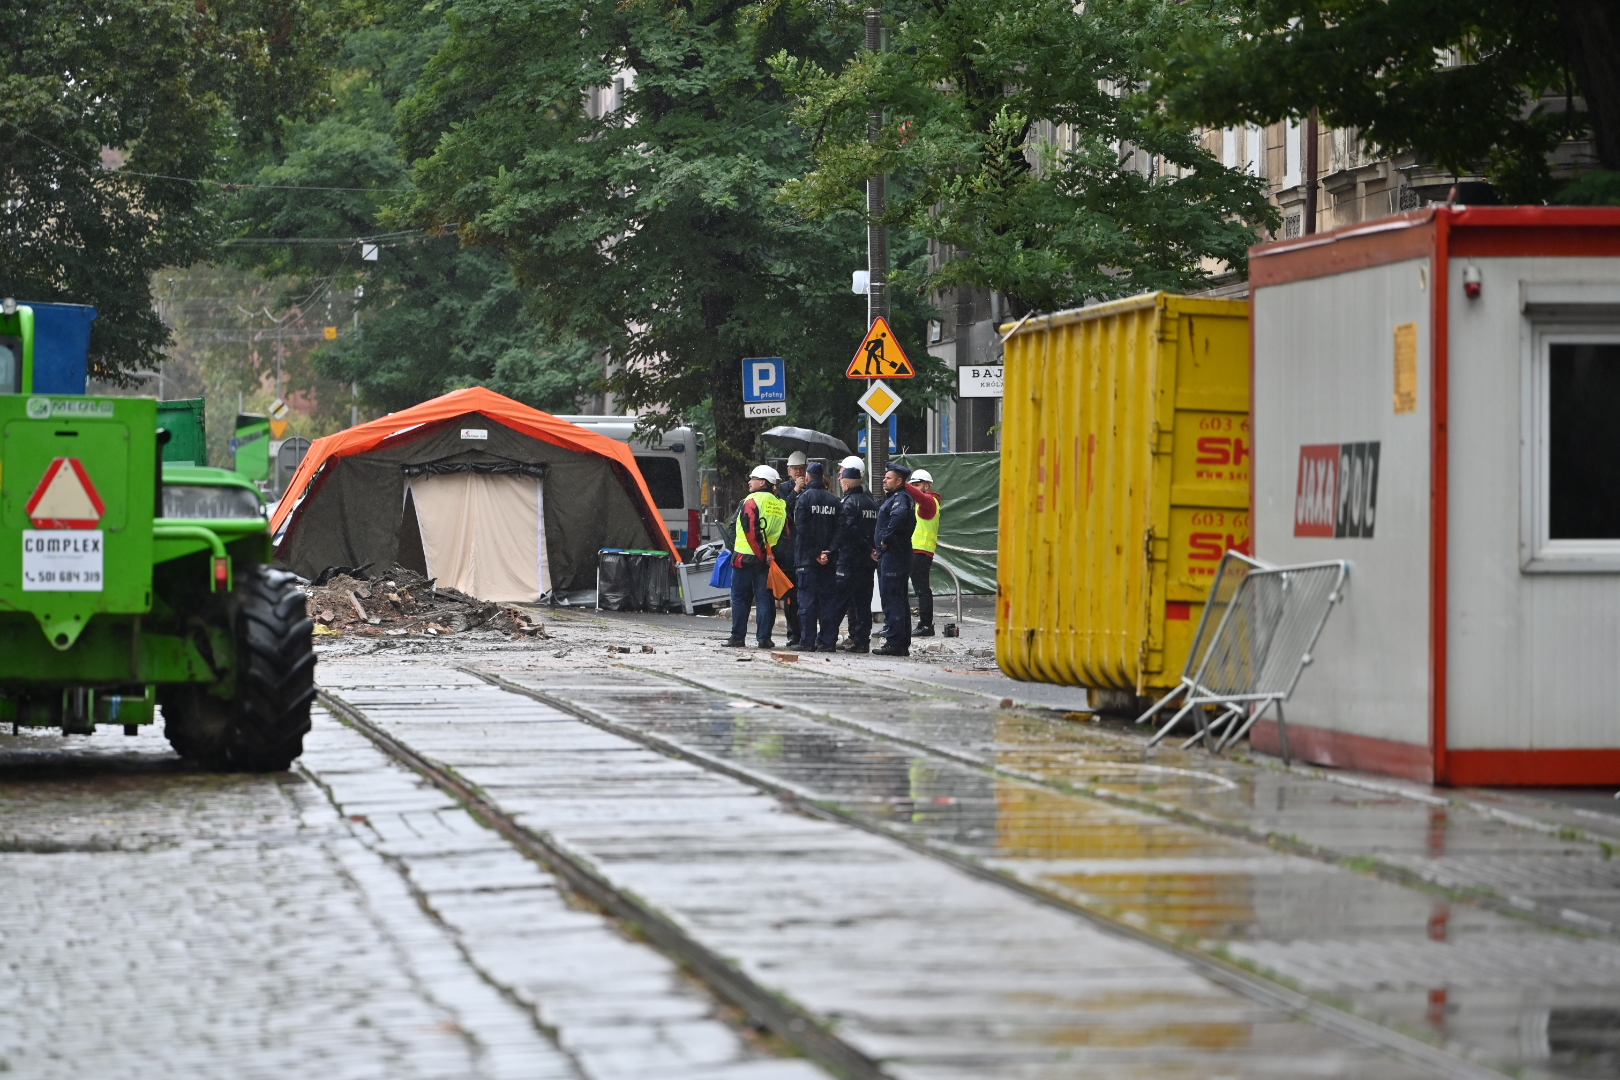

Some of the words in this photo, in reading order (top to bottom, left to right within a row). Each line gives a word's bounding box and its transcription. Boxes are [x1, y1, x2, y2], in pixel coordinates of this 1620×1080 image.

[752, 362, 776, 397] P
[760, 391, 783, 400] płatny
[749, 405, 781, 415] Koniec
[1199, 417, 1233, 431] 603
[1191, 511, 1225, 527] 603
[25, 538, 100, 553] COMPLEX
[38, 571, 56, 583] 501
